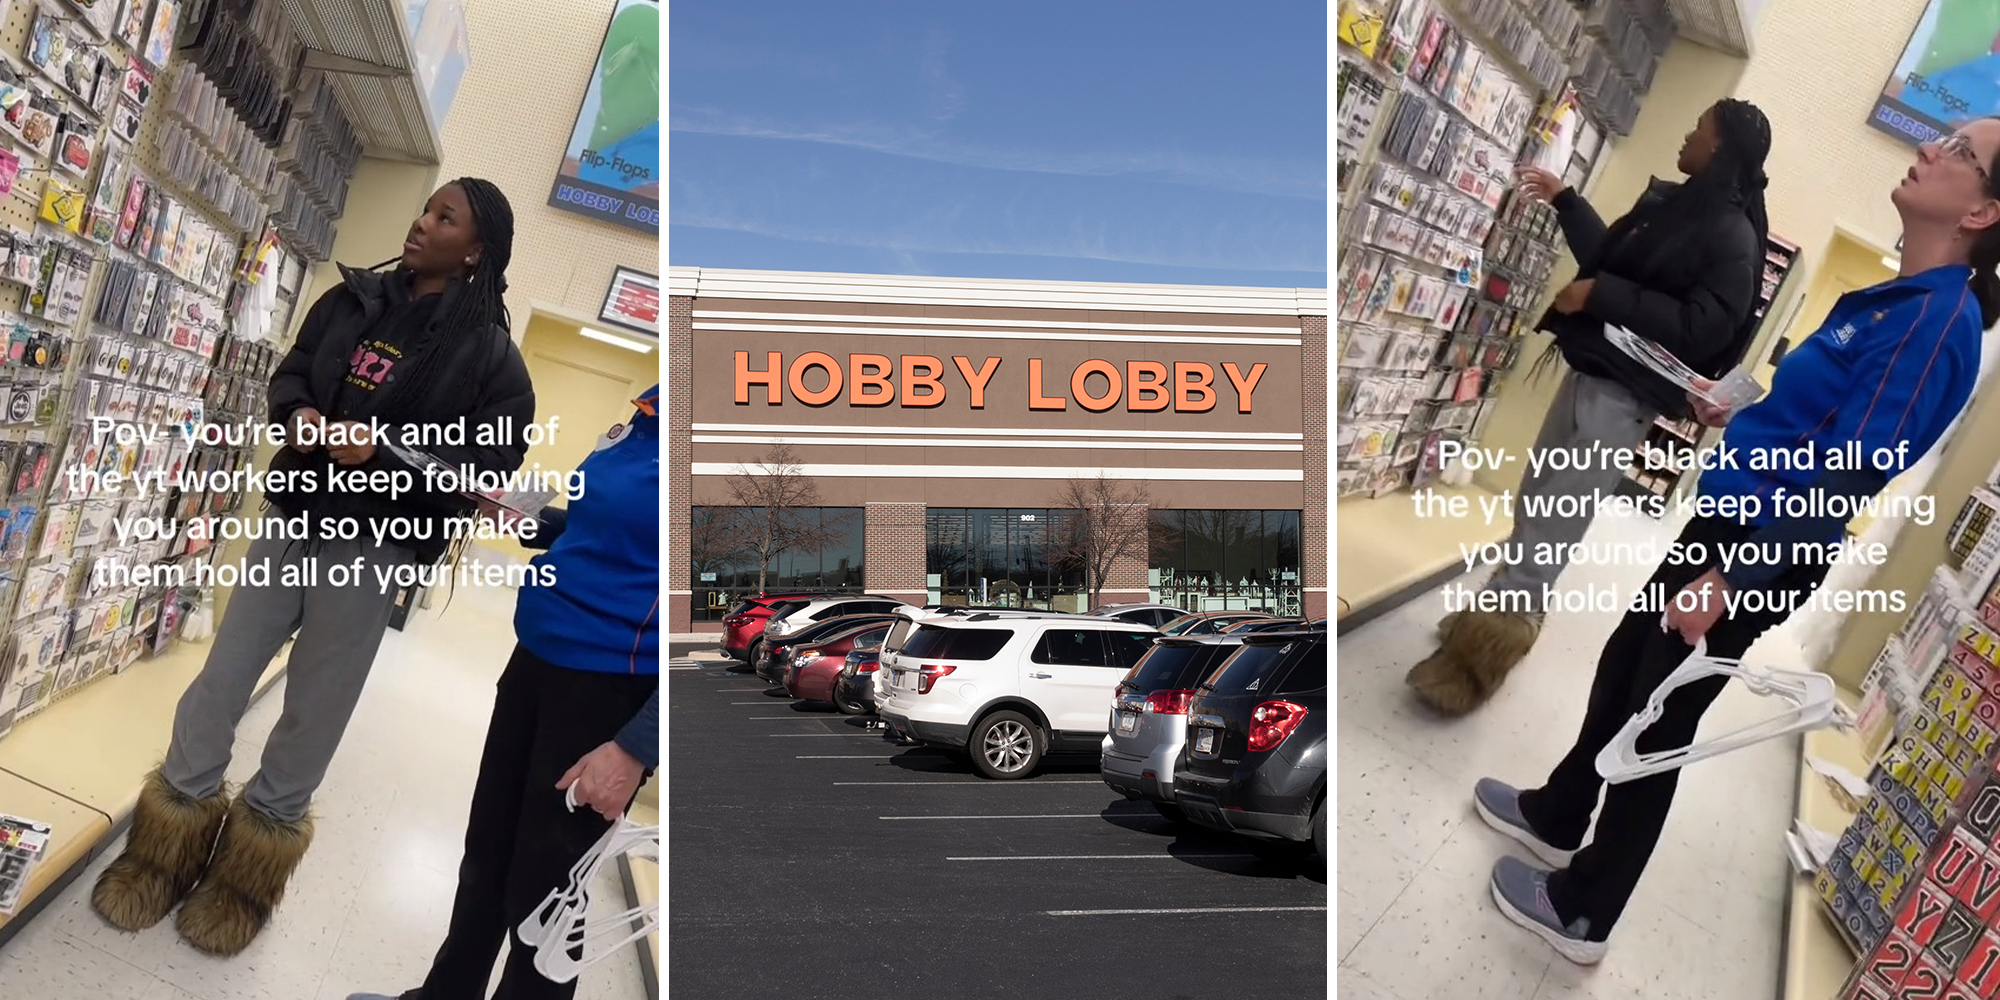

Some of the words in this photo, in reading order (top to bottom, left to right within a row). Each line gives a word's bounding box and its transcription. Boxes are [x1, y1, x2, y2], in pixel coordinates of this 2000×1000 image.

[1876, 104, 1940, 142] HOBBY
[579, 148, 651, 179] Flip-Flops
[556, 184, 624, 214] HOBBY
[733, 350, 1002, 409] HOBBY
[1028, 357, 1269, 414] LOBBY
[1021, 514, 1036, 522] 902
[1953, 651, 1969, 665] 4
[1964, 627, 1979, 645] Z
[1984, 643, 1996, 660] 1
[1943, 674, 1955, 689] 8
[1961, 687, 1972, 701] 9
[1914, 714, 1928, 731] D
[1928, 696, 1942, 712] A
[1944, 710, 1957, 727] A
[1966, 726, 1980, 743] B
[1902, 737, 1917, 752] G
[1916, 752, 1932, 770] H
[1882, 753, 1901, 771] K
[1909, 775, 1919, 792] L
[1922, 789, 1938, 810] M
[1866, 797, 1879, 815] R
[1900, 833, 1913, 849] T
[1911, 814, 1928, 829] P
[1967, 786, 2000, 836] Q
[1839, 835, 1856, 856] Z
[1855, 858, 1865, 873] 1
[1873, 877, 1886, 895] 2
[1869, 834, 1885, 853] W
[1882, 849, 1904, 875] X
[1933, 836, 1977, 887] U
[1817, 880, 1829, 896] 8
[1832, 893, 1845, 909] 9
[1829, 859, 1844, 874] 4
[1862, 896, 1876, 912] 6
[1904, 888, 1946, 937] Y
[1930, 910, 1973, 970] Z
[1870, 941, 1912, 989] 2
